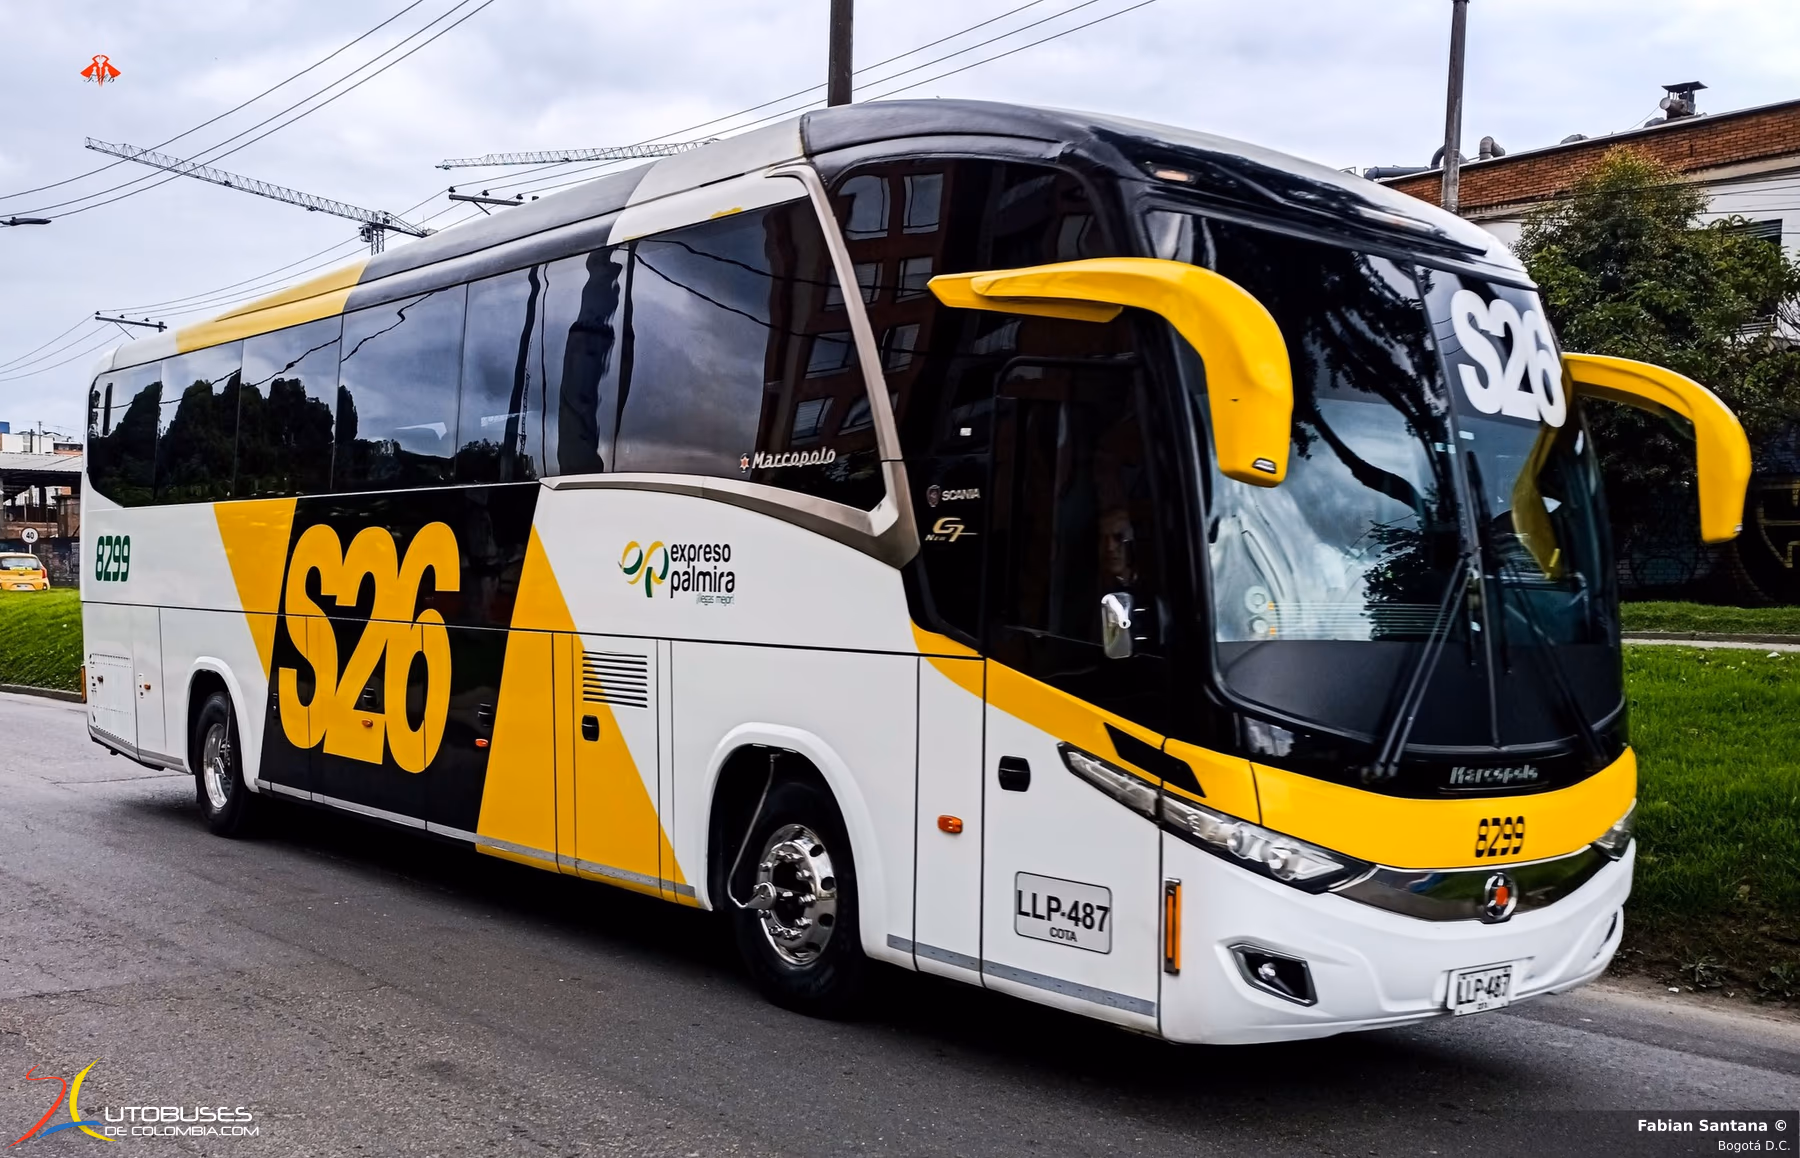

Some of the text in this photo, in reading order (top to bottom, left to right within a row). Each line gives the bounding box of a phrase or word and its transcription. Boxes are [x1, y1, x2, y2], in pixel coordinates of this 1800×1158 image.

[1451, 289, 1567, 428] S26
[752, 446, 836, 469] Marcopolo
[941, 488, 981, 501] SCANIA
[25, 531, 35, 540] 40
[95, 535, 130, 582] 8299
[670, 543, 731, 569] expreso
[670, 565, 736, 599] palmira
[278, 521, 460, 774] S26
[1475, 815, 1525, 858] 8299
[1017, 889, 1110, 932] LLP-487
[1049, 926, 1077, 942] COTA
[1457, 973, 1511, 1005] LLP-487
